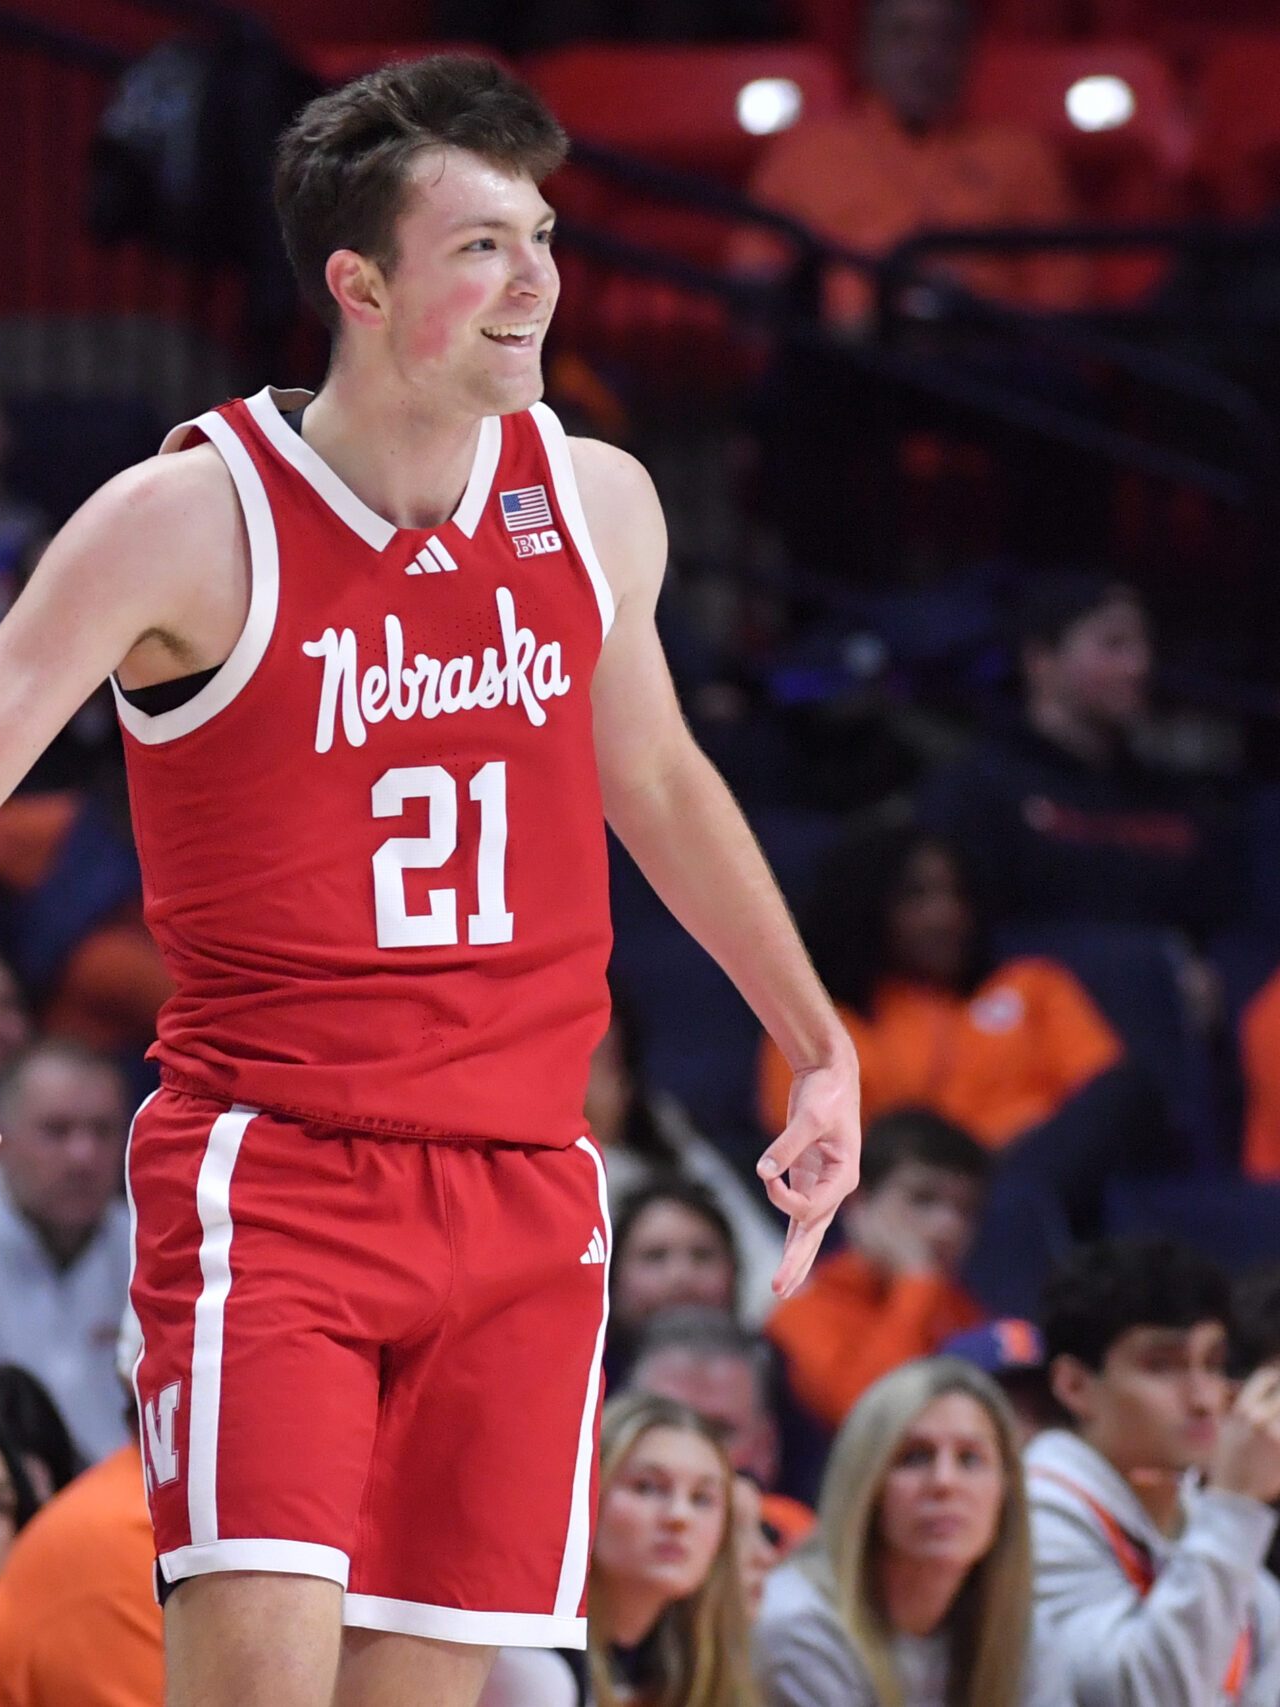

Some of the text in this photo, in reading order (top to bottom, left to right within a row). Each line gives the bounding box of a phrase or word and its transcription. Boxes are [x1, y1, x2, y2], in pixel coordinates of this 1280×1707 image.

[511, 529, 563, 558] BIG
[302, 586, 571, 754] Nebraska
[371, 761, 515, 948] 21
[144, 1380, 182, 1494] N
